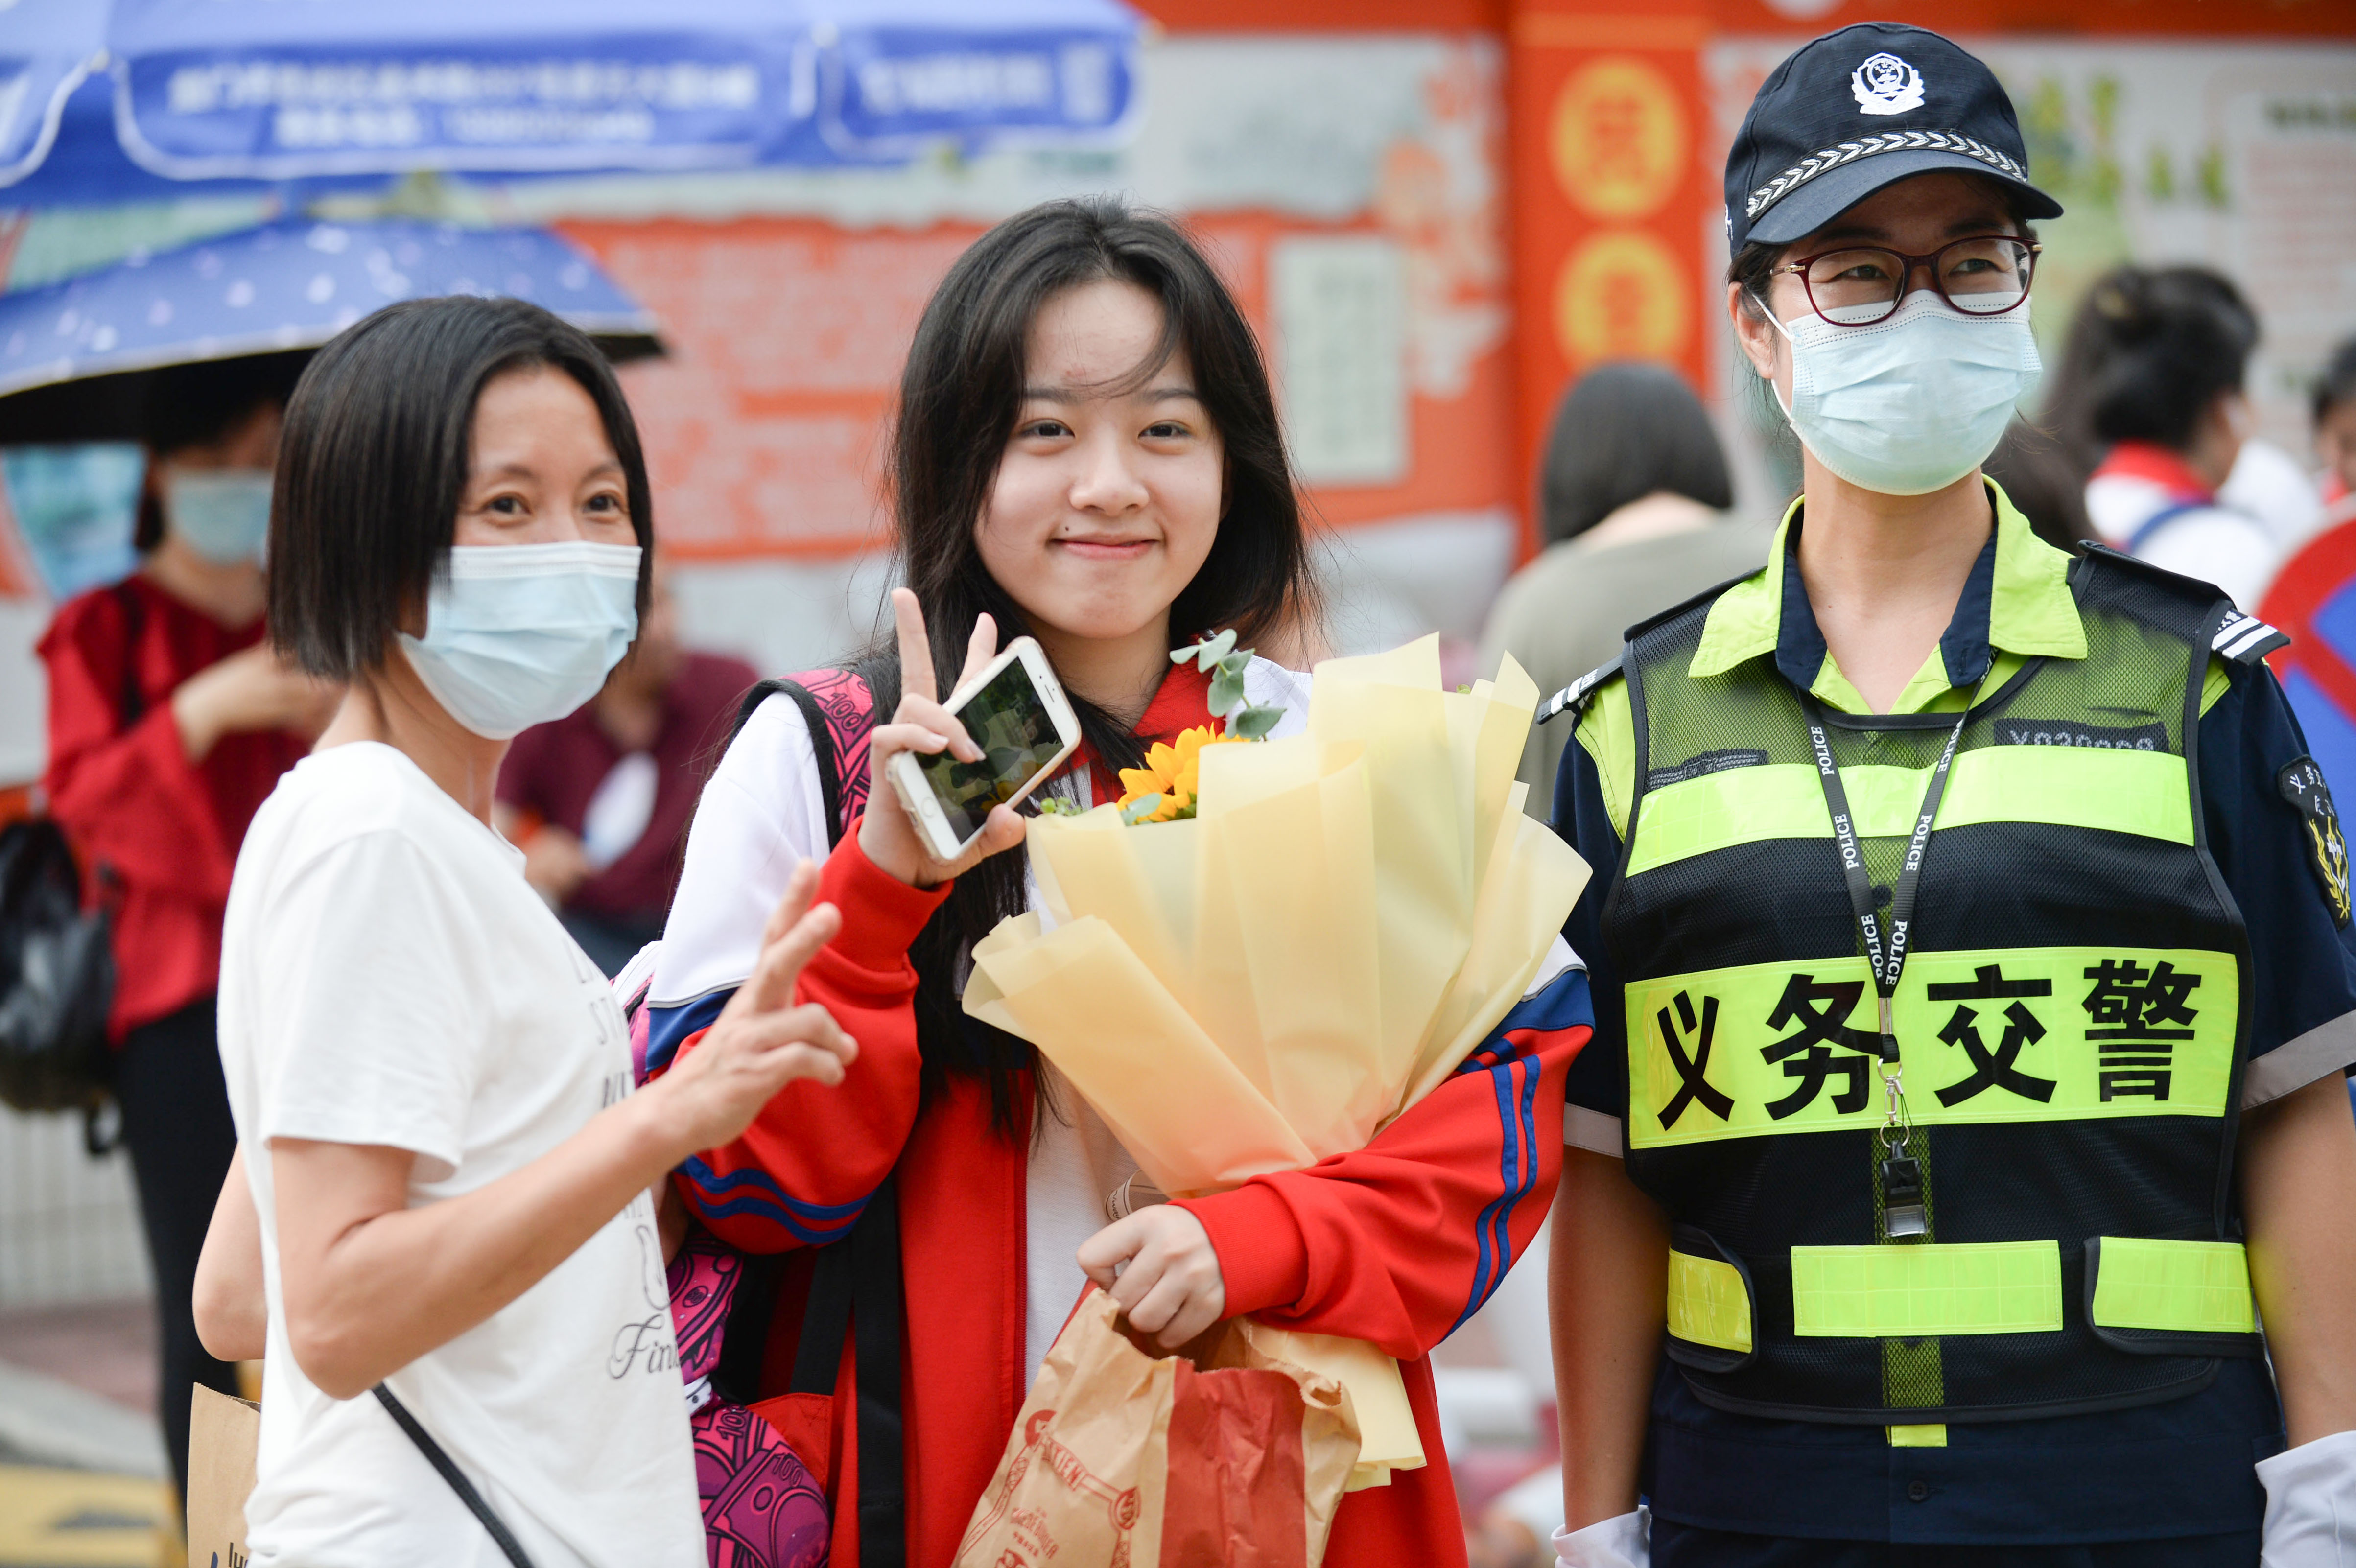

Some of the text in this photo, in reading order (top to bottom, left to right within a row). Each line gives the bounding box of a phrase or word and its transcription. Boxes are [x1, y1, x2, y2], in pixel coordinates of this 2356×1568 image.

[825, 693, 862, 731] 100
[1811, 726, 1835, 776] POLICE
[1937, 719, 1964, 773] POLICE
[1834, 814, 1860, 870] POLICE
[1905, 815, 1932, 871] POLICE
[1861, 914, 1884, 979] POLICE
[1885, 919, 1908, 985] POLICE
[1656, 959, 2201, 1132] 义务交警
[772, 1453, 803, 1488] 100
